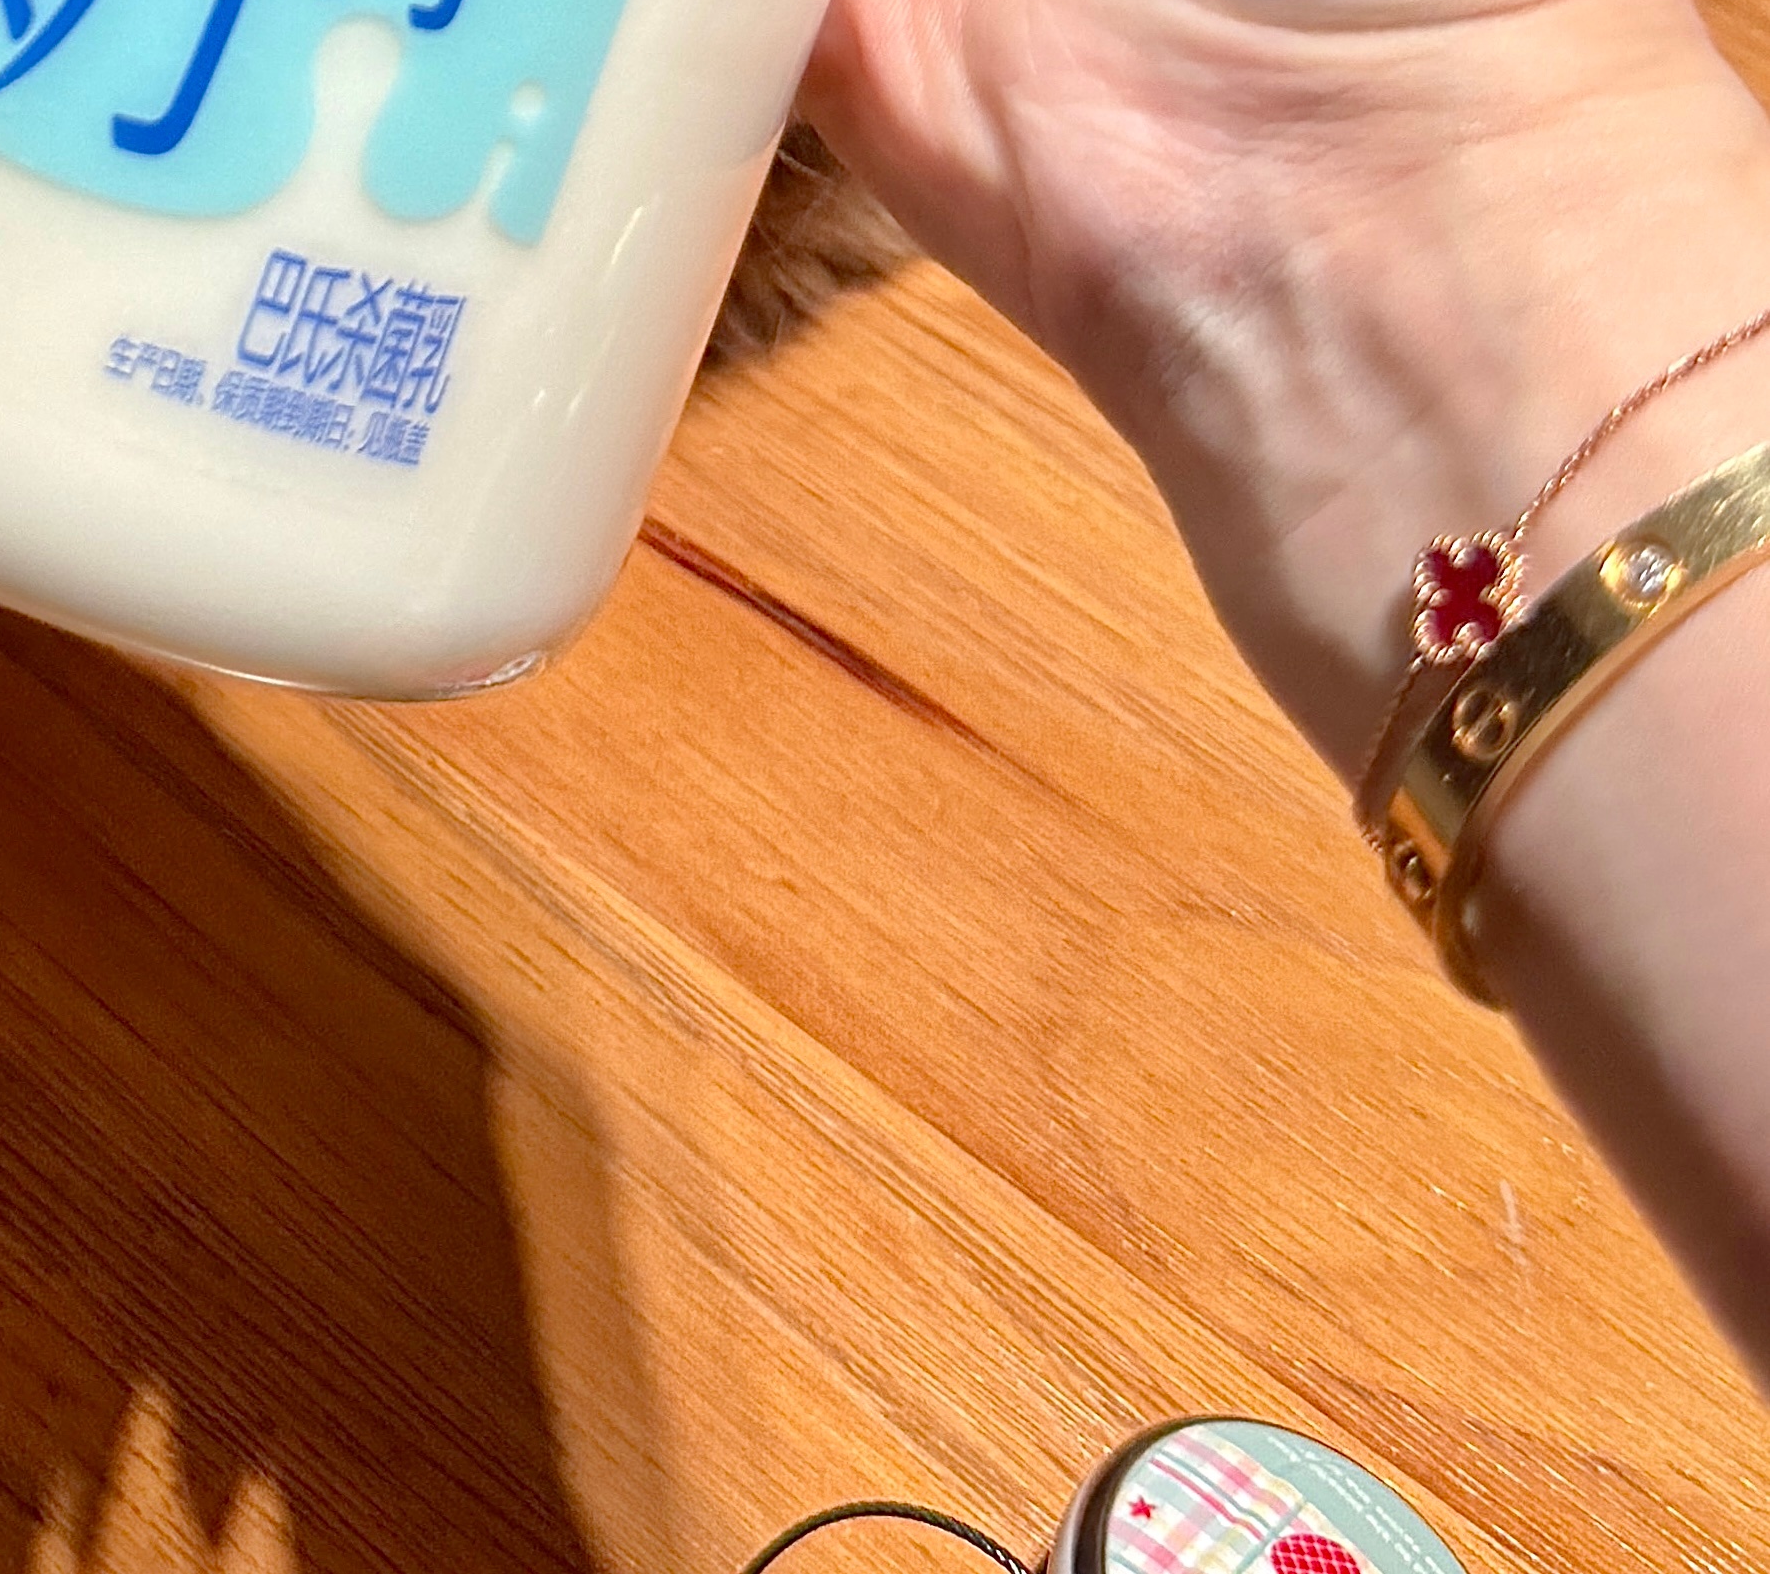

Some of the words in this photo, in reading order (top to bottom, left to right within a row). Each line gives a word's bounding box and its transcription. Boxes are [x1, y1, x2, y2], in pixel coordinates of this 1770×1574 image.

[236, 247, 467, 415] 巴氏杀菌乳
